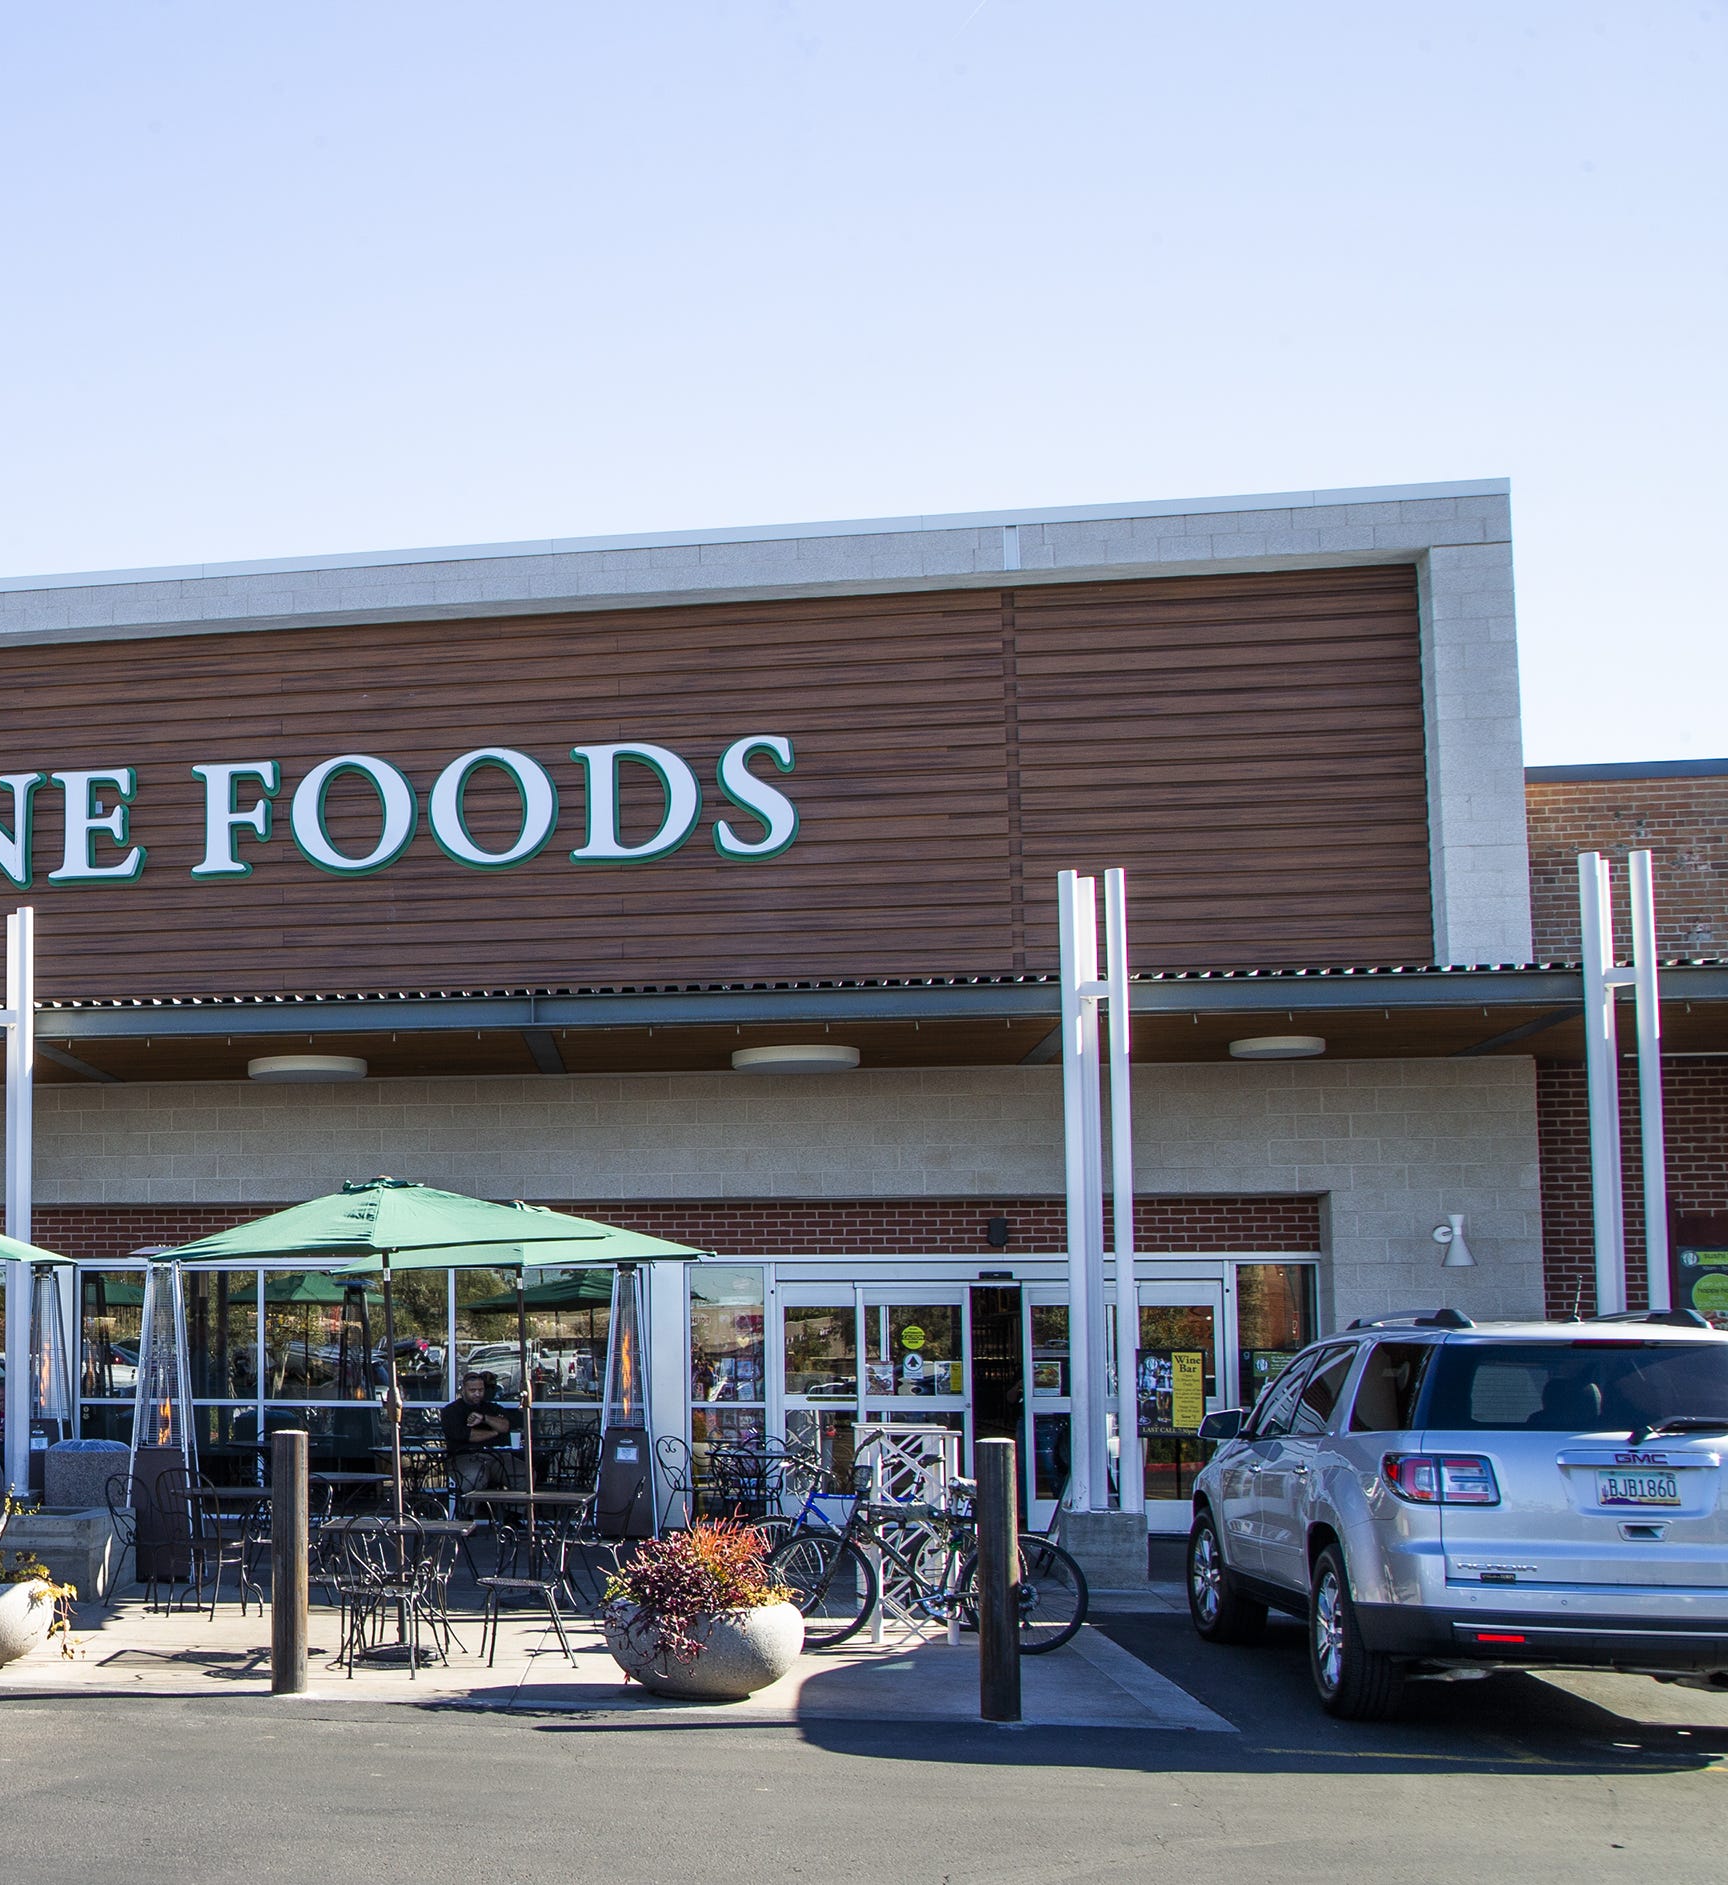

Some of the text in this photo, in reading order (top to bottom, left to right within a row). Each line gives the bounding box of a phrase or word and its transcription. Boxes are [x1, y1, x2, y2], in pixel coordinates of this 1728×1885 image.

[191, 735, 799, 878] FOODS
[1174, 1355, 1202, 1365] Wine
[1179, 1364, 1197, 1373] Bar
[1614, 1453, 1669, 1465] GMC
[1607, 1478, 1677, 1498] BJB1860
